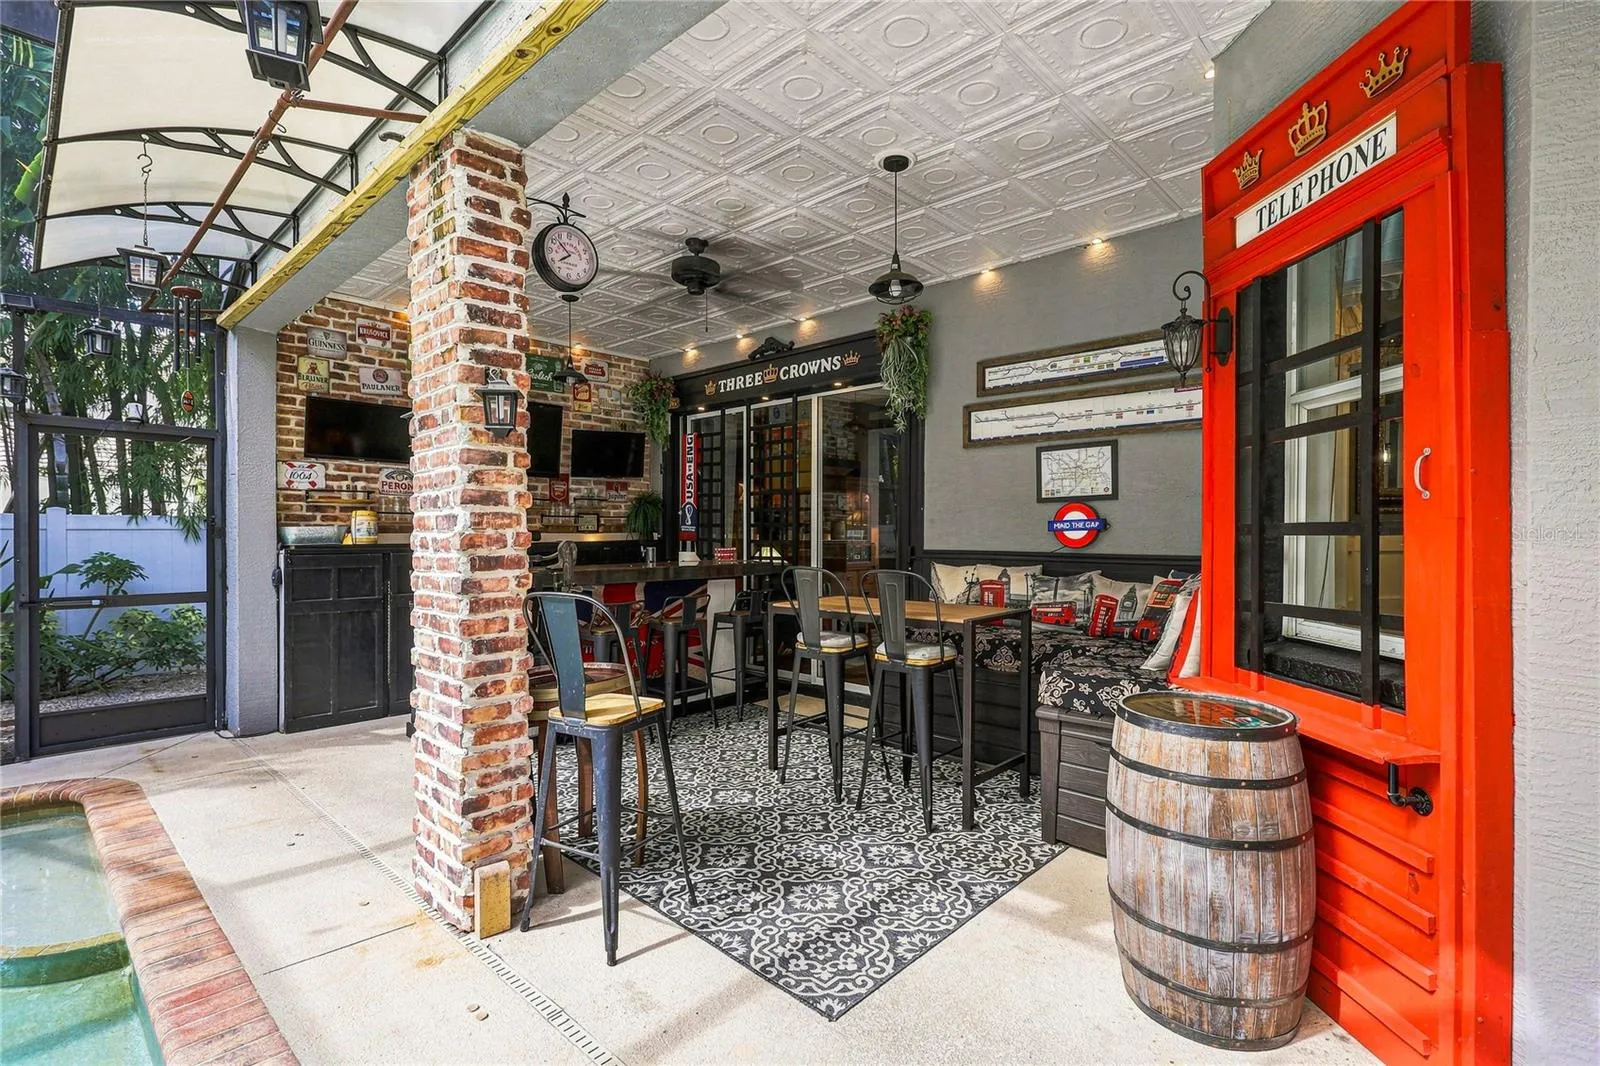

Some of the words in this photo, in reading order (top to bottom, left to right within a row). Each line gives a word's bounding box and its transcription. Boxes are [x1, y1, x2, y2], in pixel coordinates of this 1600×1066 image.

[1255, 127, 1388, 234] TELEPHONE
[308, 338, 346, 352] GUINNESS
[718, 371, 763, 393] THREE
[779, 355, 842, 381] CROWNS
[361, 382, 401, 392] PAULANER
[381, 480, 414, 491] PERON
[686, 472, 694, 499] USA
[1053, 522, 1071, 530] MIND
[1072, 521, 1084, 529] THE
